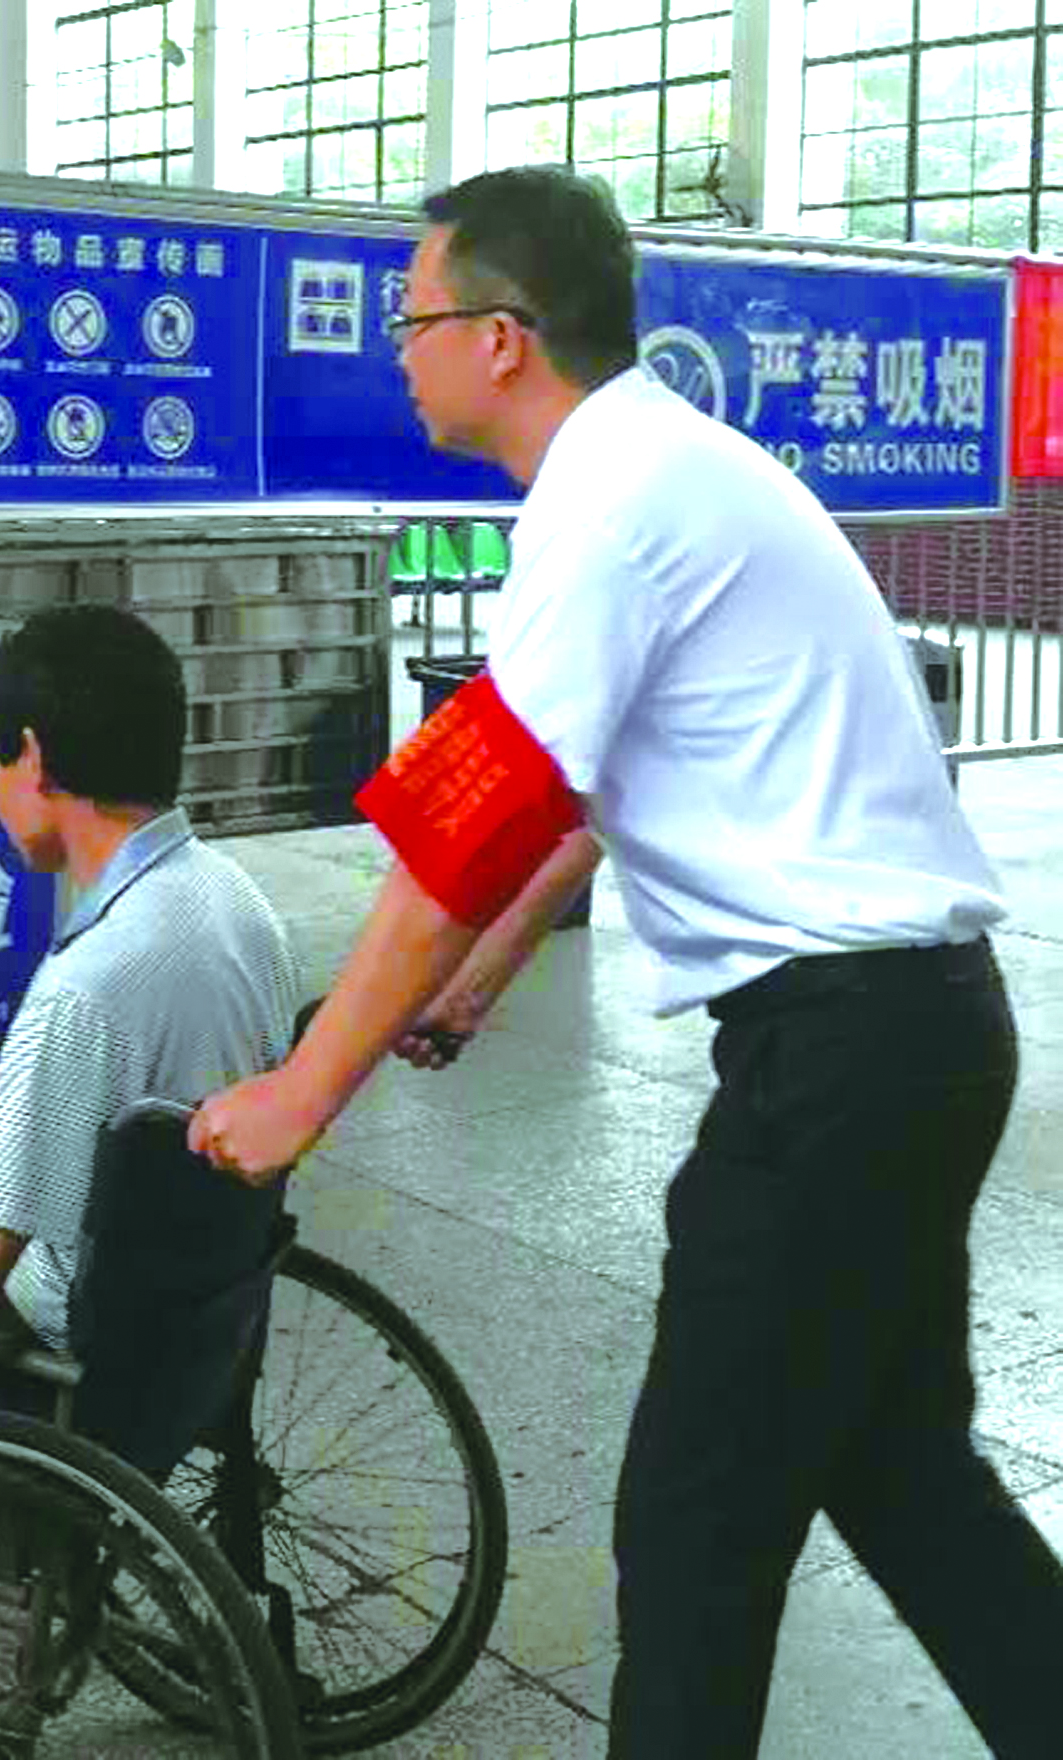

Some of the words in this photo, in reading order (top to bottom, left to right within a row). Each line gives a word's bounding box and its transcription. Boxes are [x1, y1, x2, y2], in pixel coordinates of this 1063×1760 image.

[744, 330, 987, 431] 严禁吸烟
[823, 443, 981, 475] SMOKING
